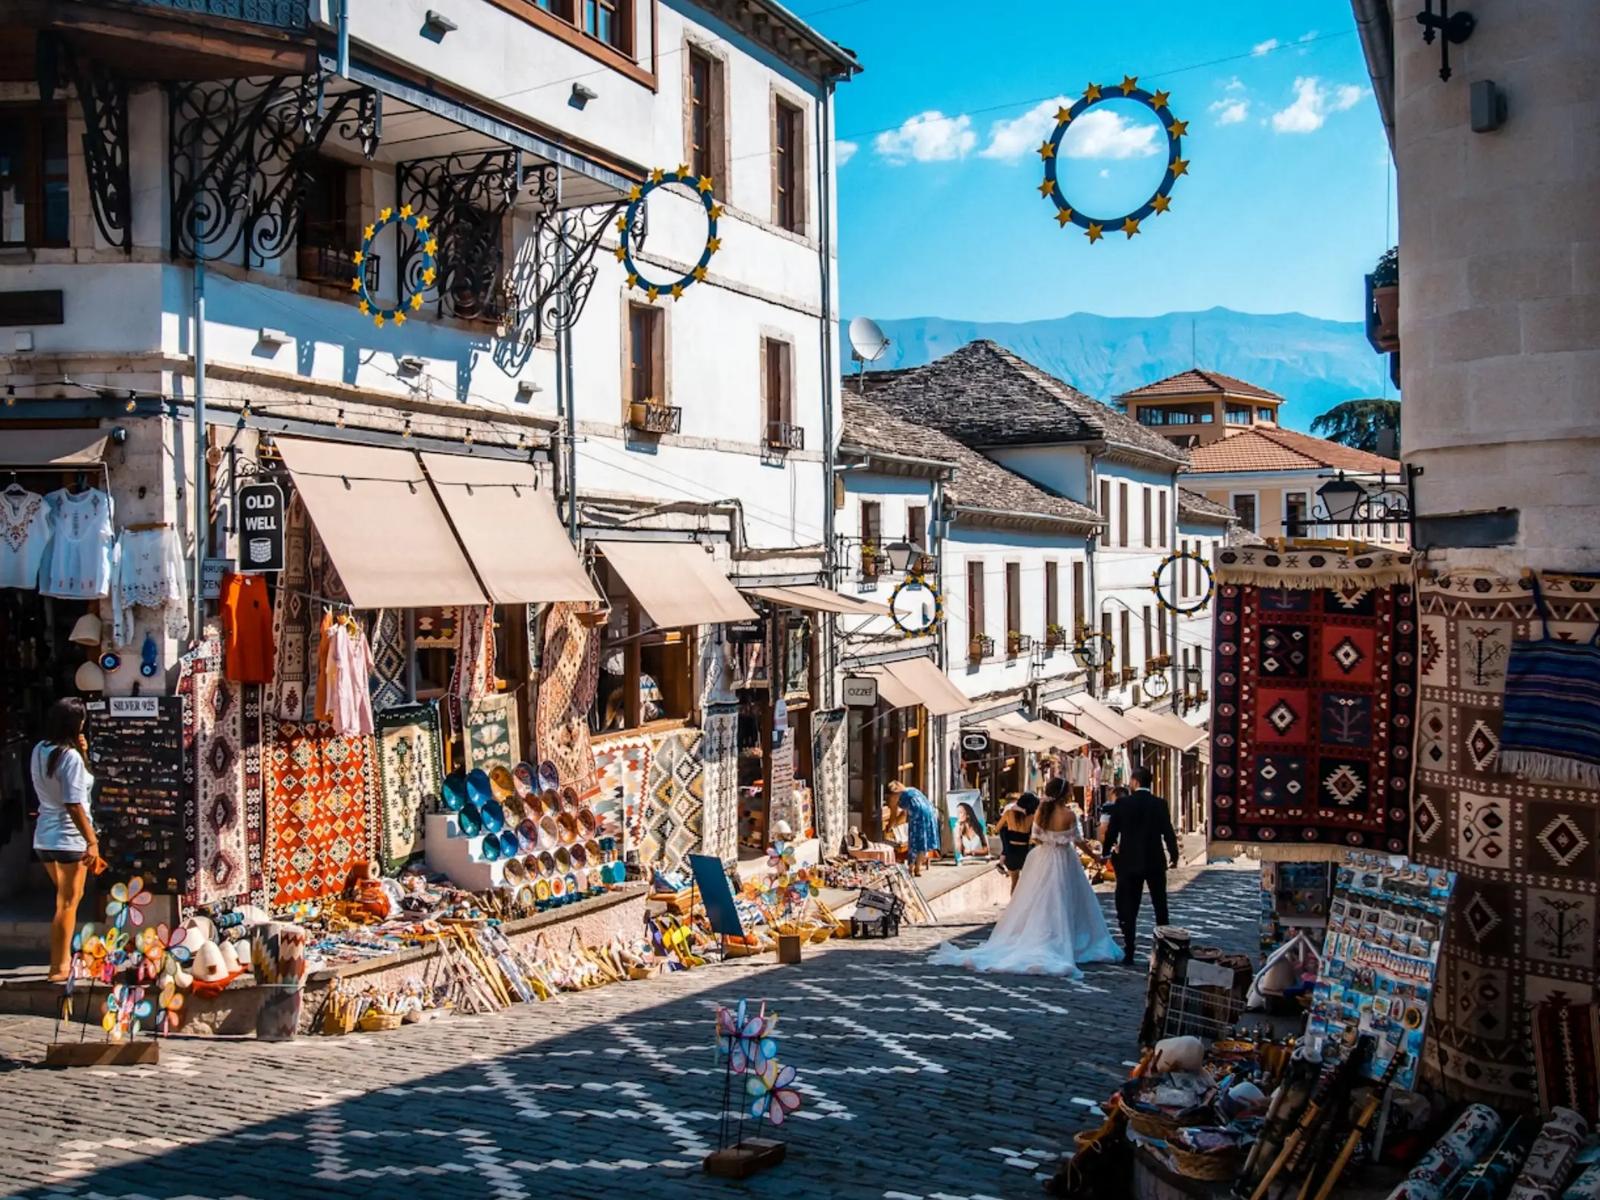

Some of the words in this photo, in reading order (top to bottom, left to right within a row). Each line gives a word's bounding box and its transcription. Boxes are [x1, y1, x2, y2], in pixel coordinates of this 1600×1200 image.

[246, 495, 275, 509] OLD
[245, 516, 277, 531] WELL
[112, 701, 141, 712] SILVER
[142, 701, 155, 712] 925
